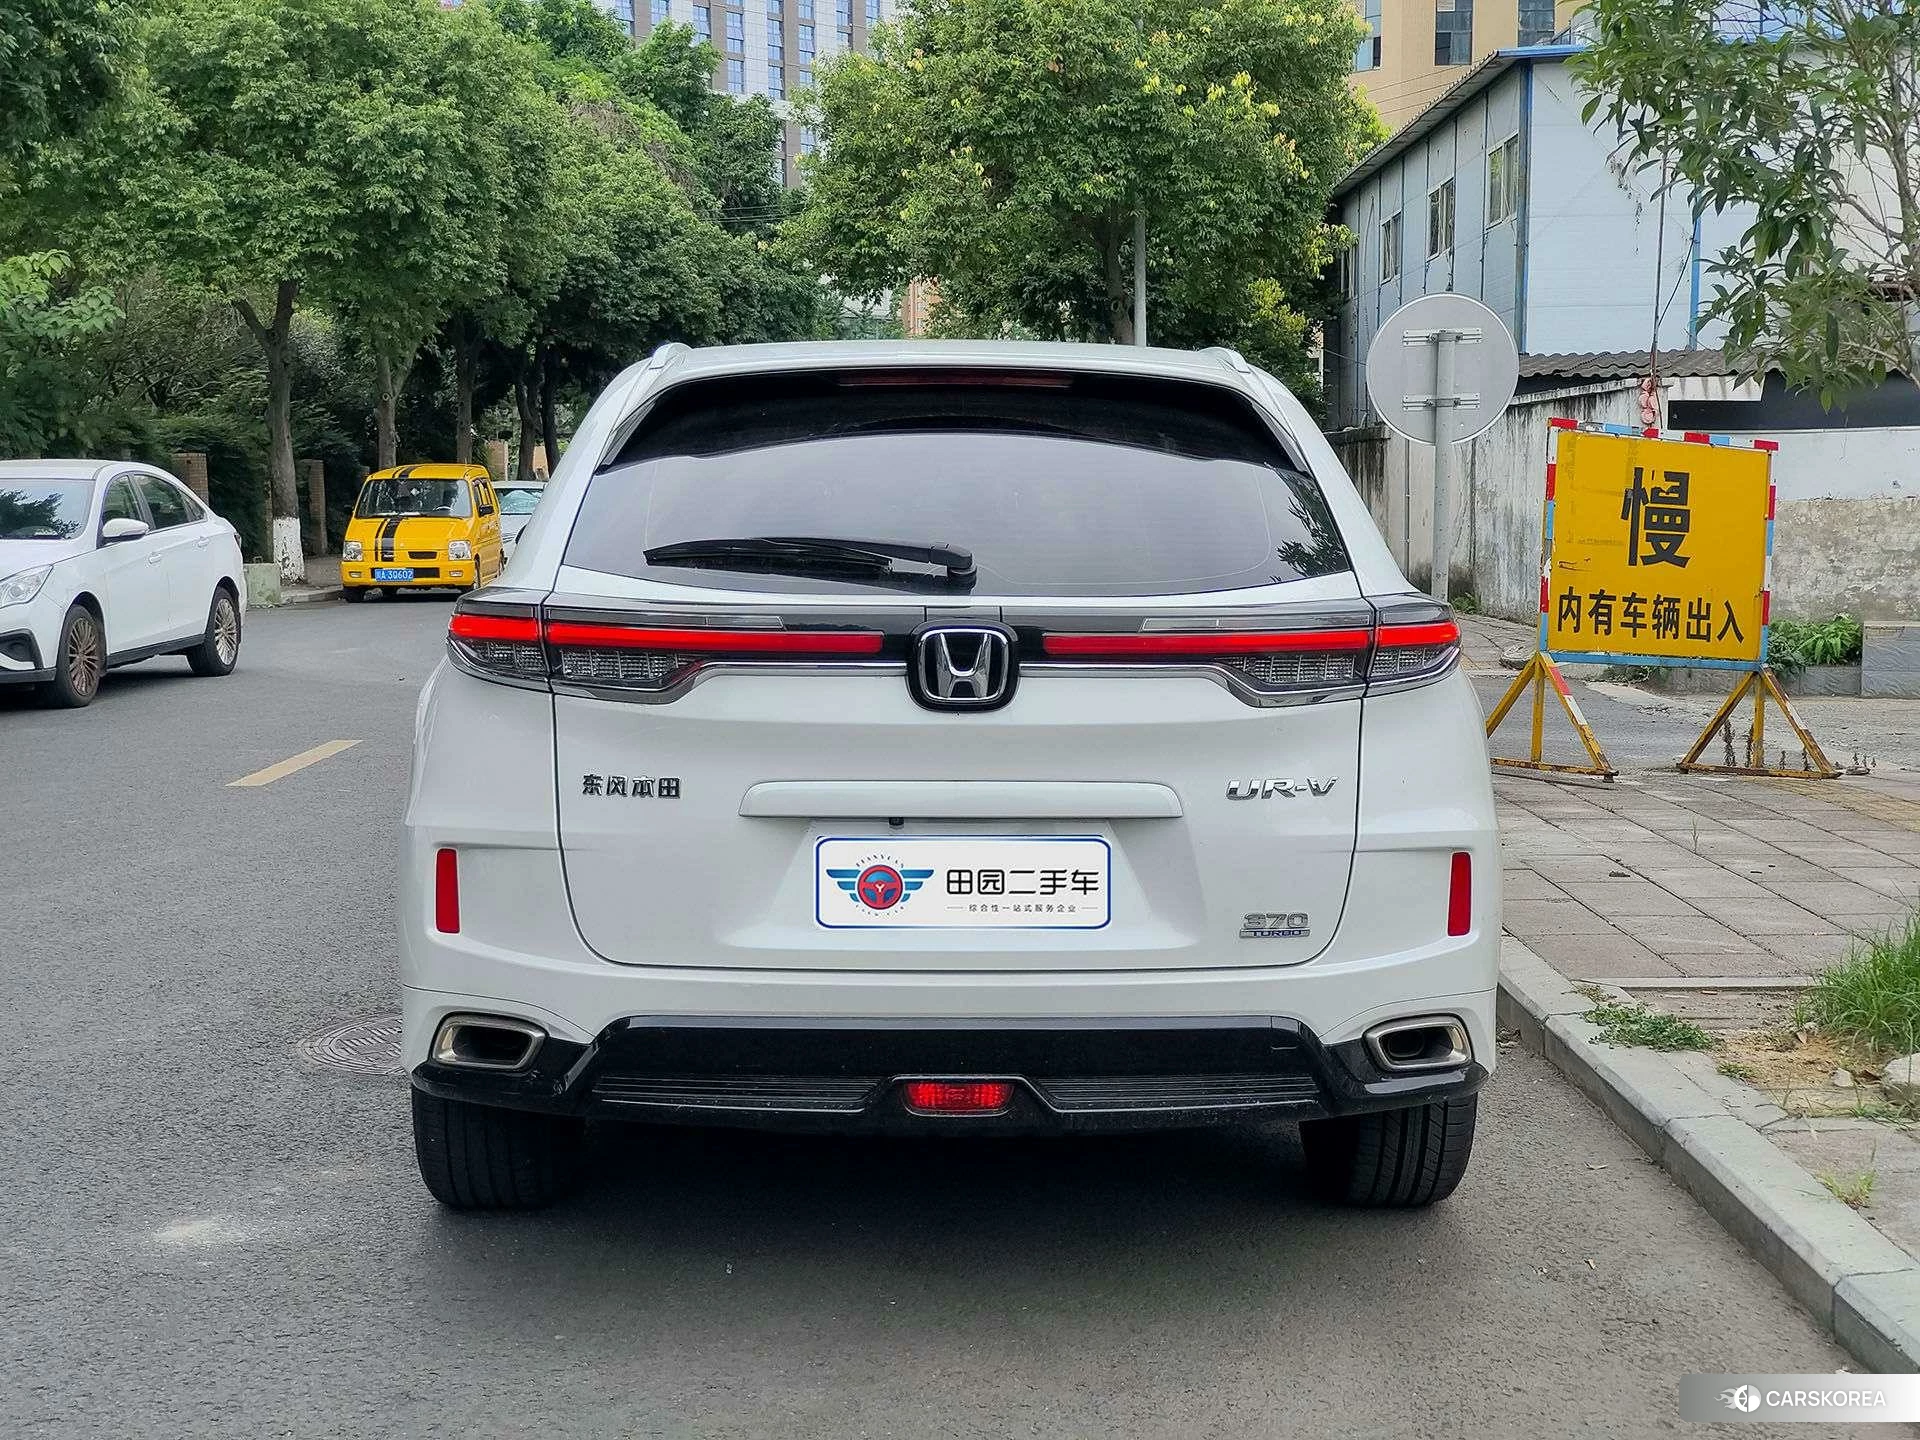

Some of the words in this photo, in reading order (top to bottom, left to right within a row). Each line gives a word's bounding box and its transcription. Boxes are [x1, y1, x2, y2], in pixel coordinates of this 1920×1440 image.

[1621, 467, 1690, 568] 慢
[1557, 586, 1745, 643] 内有车辆出入
[582, 774, 681, 798] 东风本田
[1226, 777, 1339, 800] UR-V
[946, 868, 1100, 896] 田园二手车
[1243, 912, 1309, 929] 370
[1252, 929, 1302, 937] TURBO
